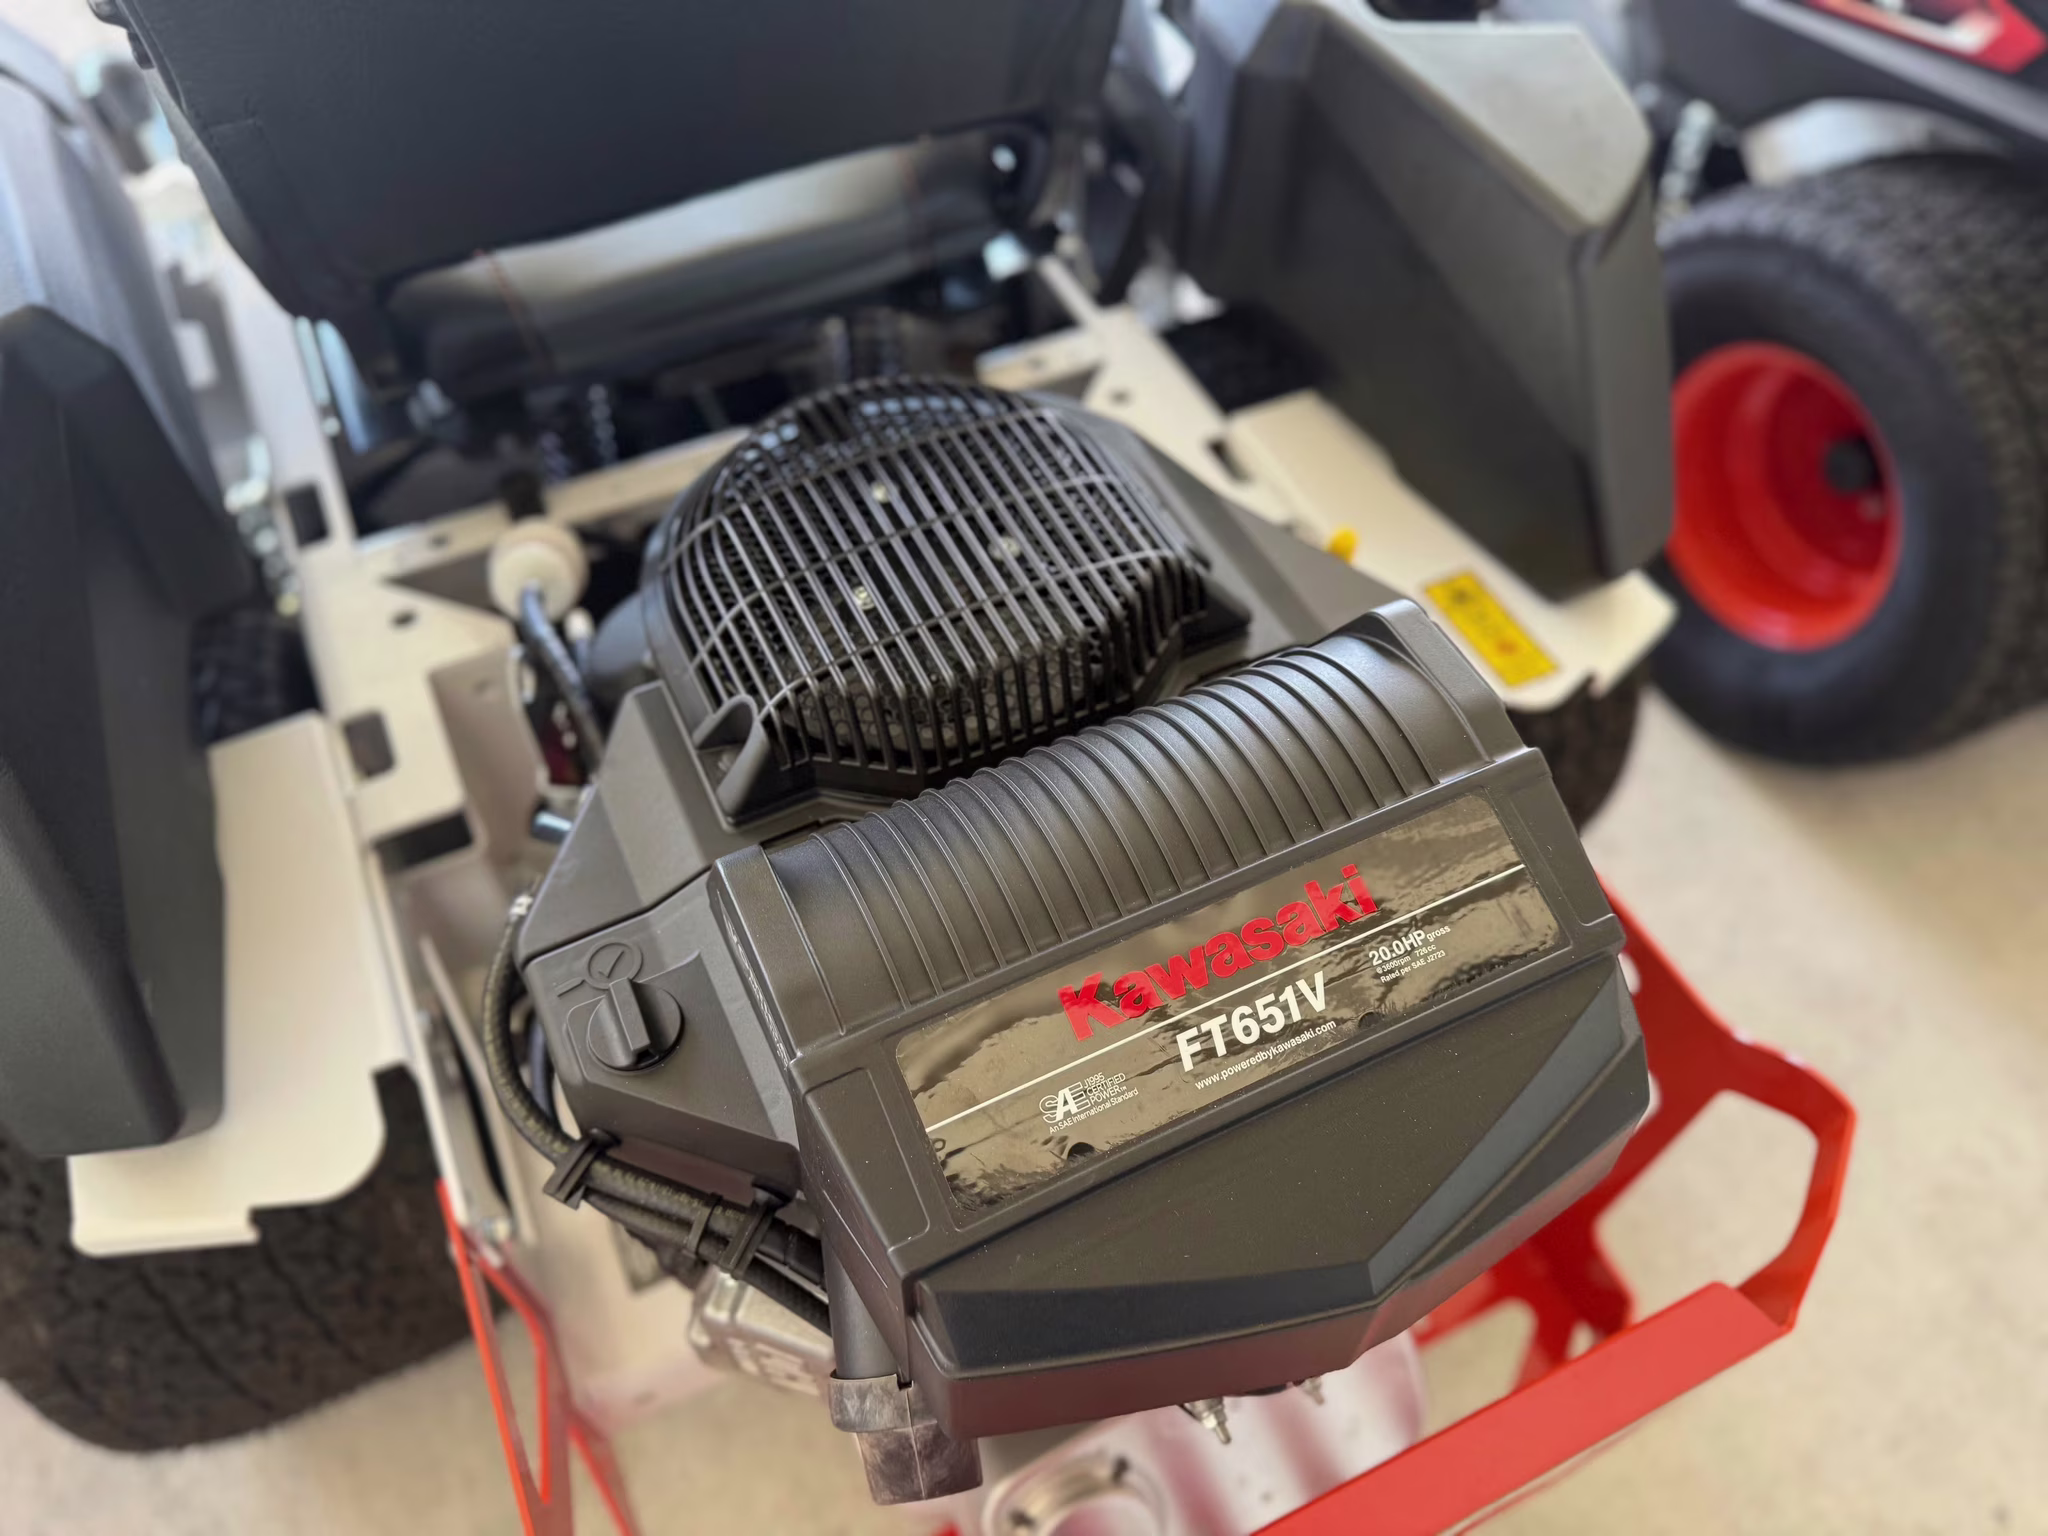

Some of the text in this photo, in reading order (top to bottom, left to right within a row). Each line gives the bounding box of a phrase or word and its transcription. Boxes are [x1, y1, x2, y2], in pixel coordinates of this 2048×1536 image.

[1057, 863, 1379, 1042] Kawasaki
[1427, 926, 1451, 942] gross
[1380, 949, 1446, 984] Rated per SAE J2723
[1175, 970, 1327, 1073] FT651V
[1195, 1019, 1337, 1090] www.poweredbykawasaki.com
[1083, 1072, 1105, 1089] J1995
[1086, 1073, 1126, 1096] CERTIFIED
[1039, 1081, 1091, 1123] SAE
[1049, 1087, 1139, 1134] An SAE International Standard
